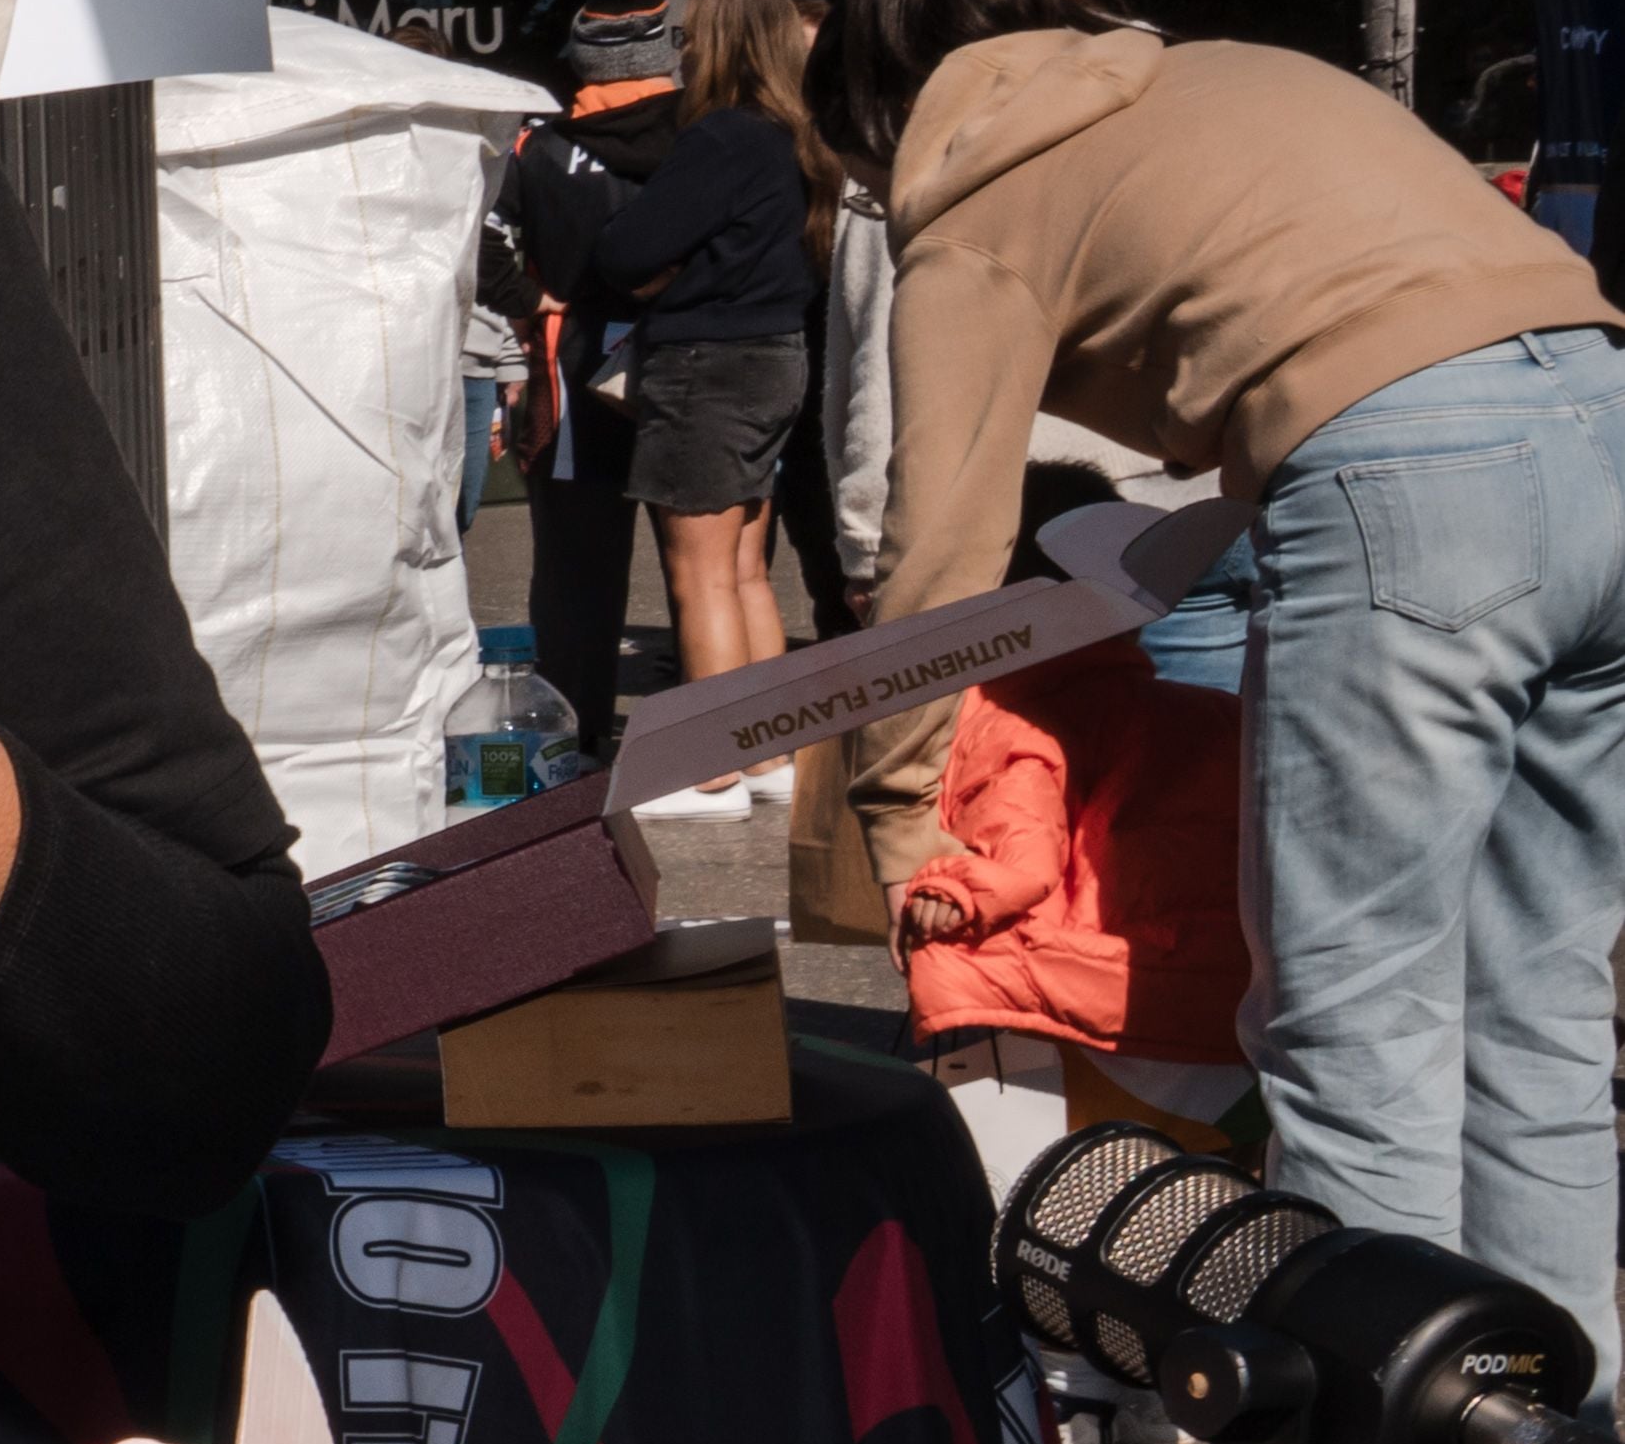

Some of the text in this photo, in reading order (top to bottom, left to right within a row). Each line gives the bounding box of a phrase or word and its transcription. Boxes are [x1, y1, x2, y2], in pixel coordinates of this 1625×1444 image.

[728, 623, 1034, 752] AUTHENTIC FLAVOUR
[1460, 1354, 1546, 1376] PODMIC
